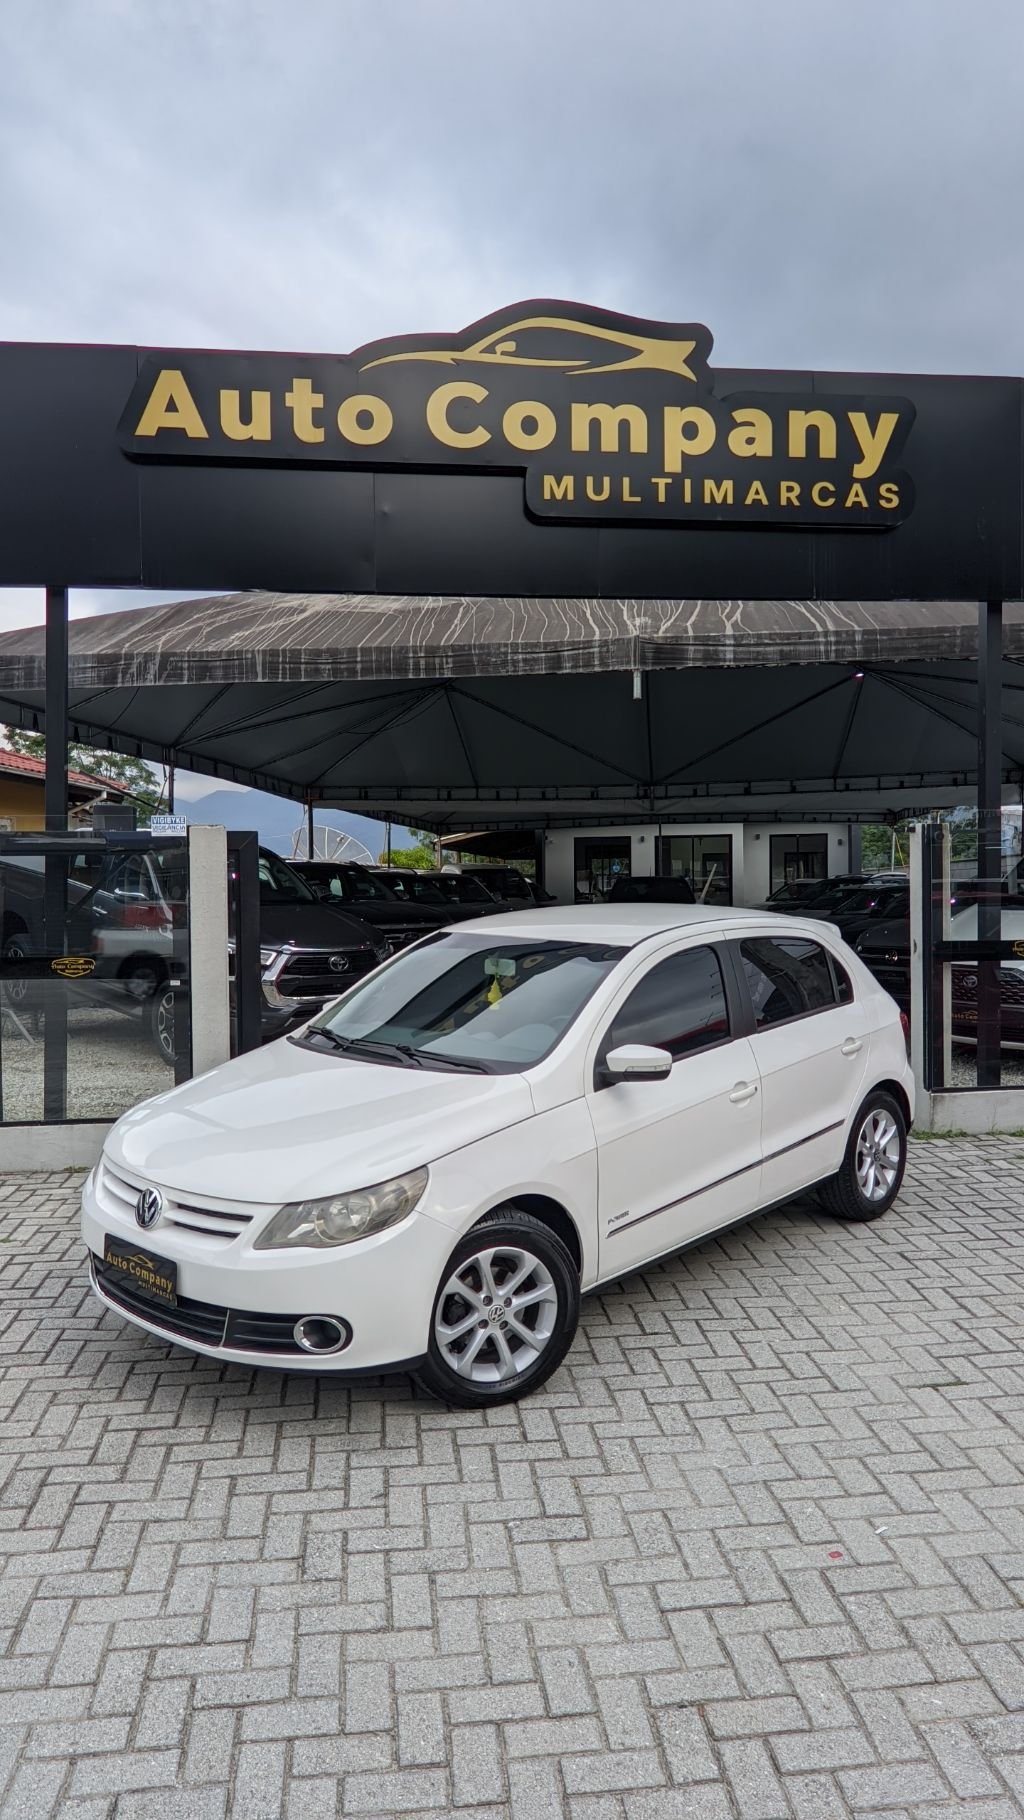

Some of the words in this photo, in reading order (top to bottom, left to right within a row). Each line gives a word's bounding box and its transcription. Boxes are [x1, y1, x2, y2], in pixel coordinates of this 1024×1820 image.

[134, 369, 394, 446] Auto
[425, 380, 899, 479] Company
[542, 474, 903, 510] MULTIMARCAS
[106, 1251, 128, 1270] Auto
[129, 1262, 173, 1292] Company
